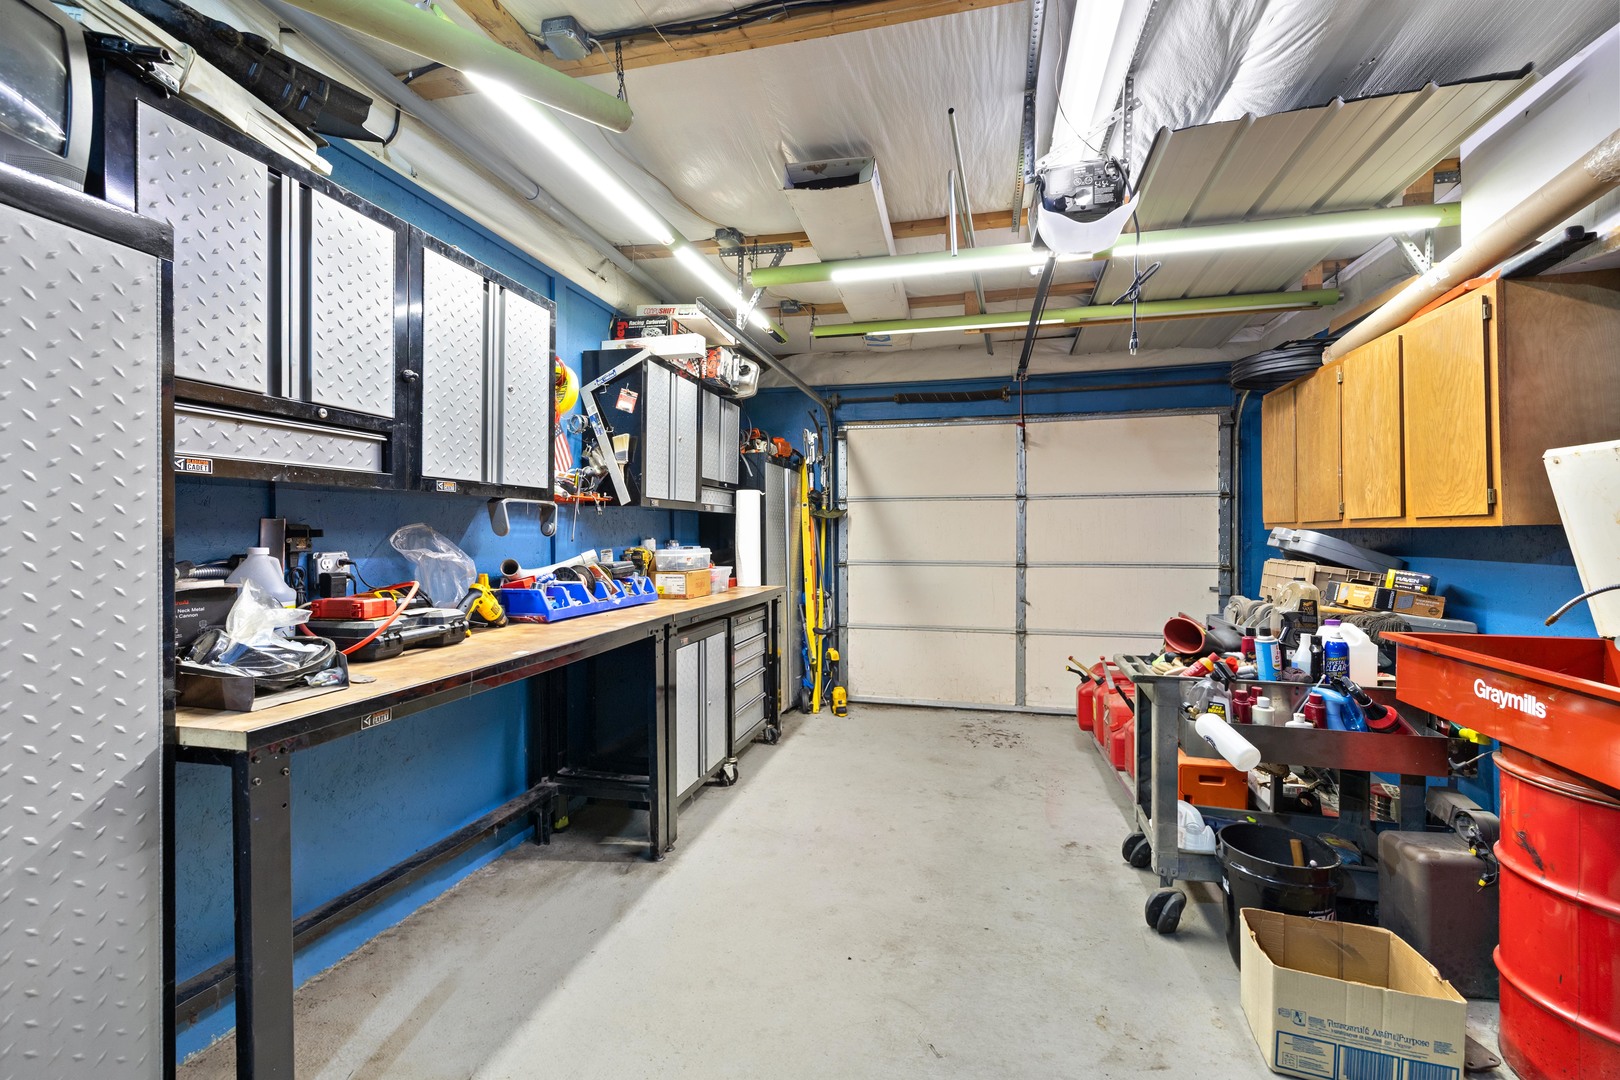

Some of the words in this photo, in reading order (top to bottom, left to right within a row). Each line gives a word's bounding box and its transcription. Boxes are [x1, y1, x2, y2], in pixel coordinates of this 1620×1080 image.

[1396, 576, 1420, 584] RAVEN
[1325, 663, 1347, 671] CLEAR
[1473, 678, 1547, 719] Graymills
